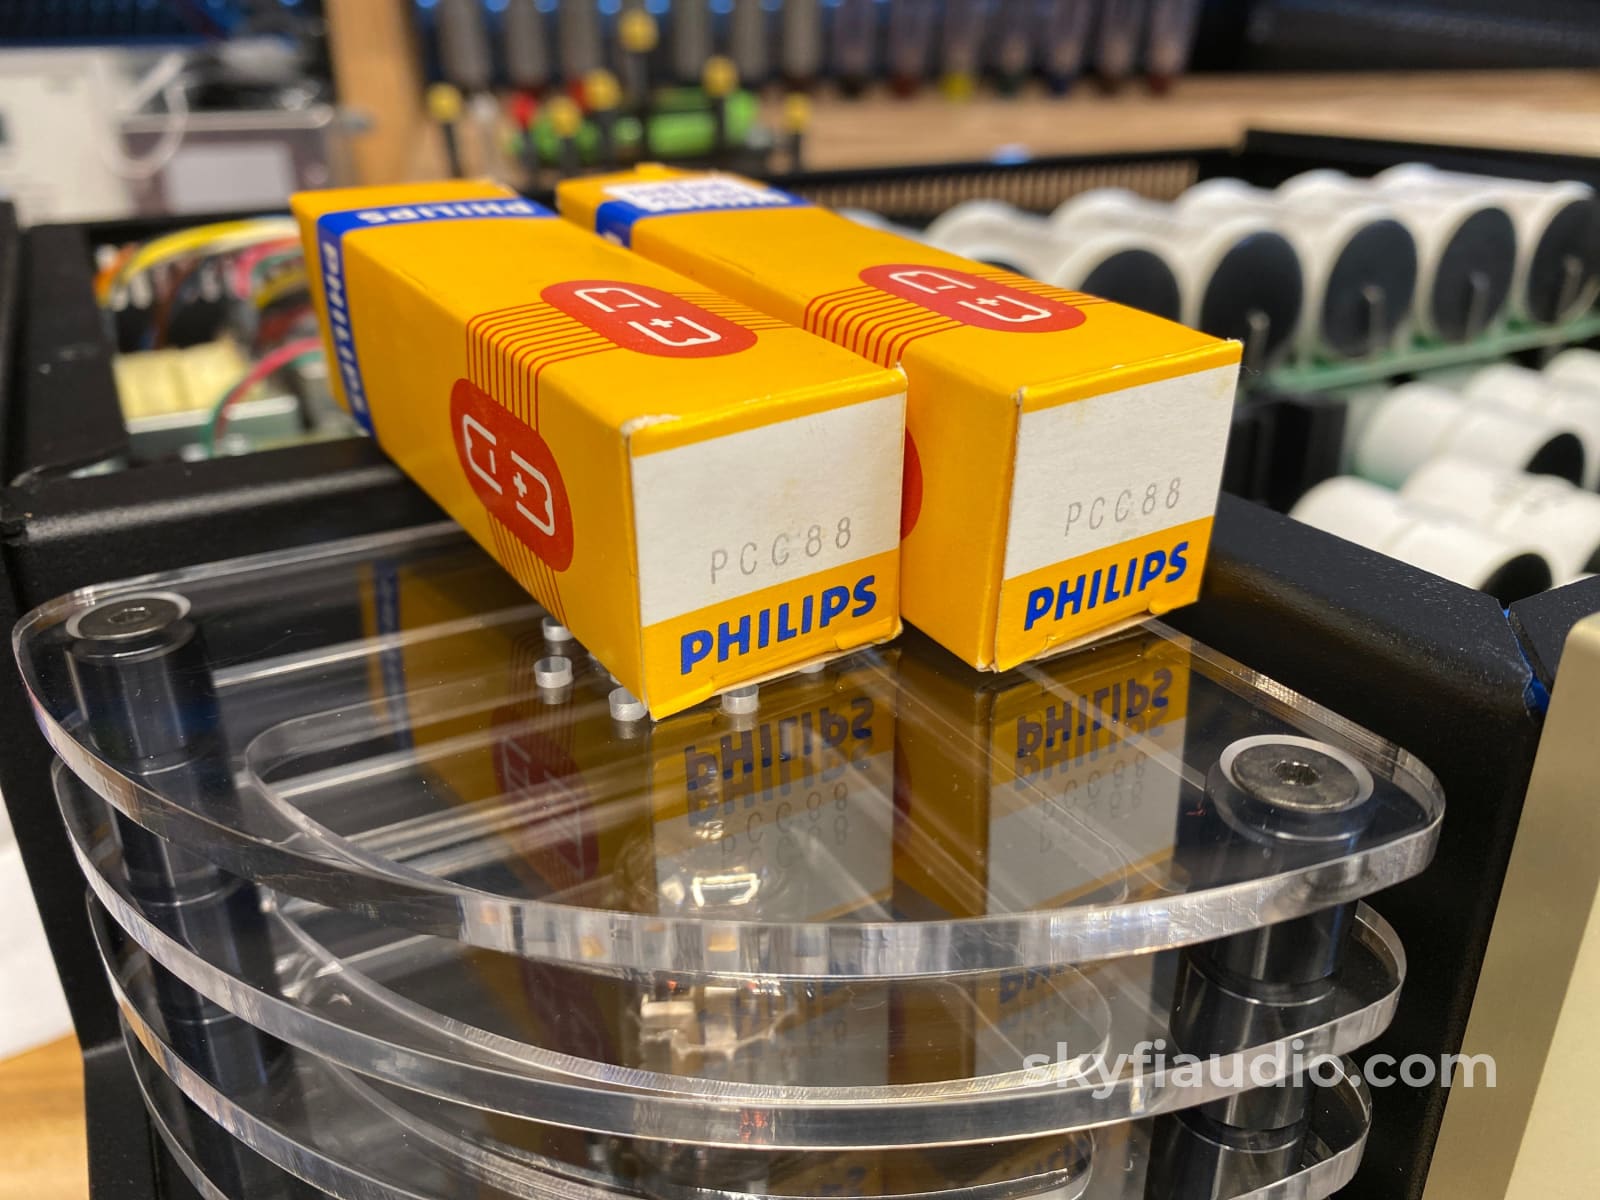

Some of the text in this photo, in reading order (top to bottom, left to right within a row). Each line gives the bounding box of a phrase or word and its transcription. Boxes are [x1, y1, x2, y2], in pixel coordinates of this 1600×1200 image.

[357, 200, 534, 224] PHILIPS
[1064, 477, 1182, 537] PCC88
[1023, 541, 1189, 631] PHILIPS
[679, 575, 878, 675] PHILIPS
